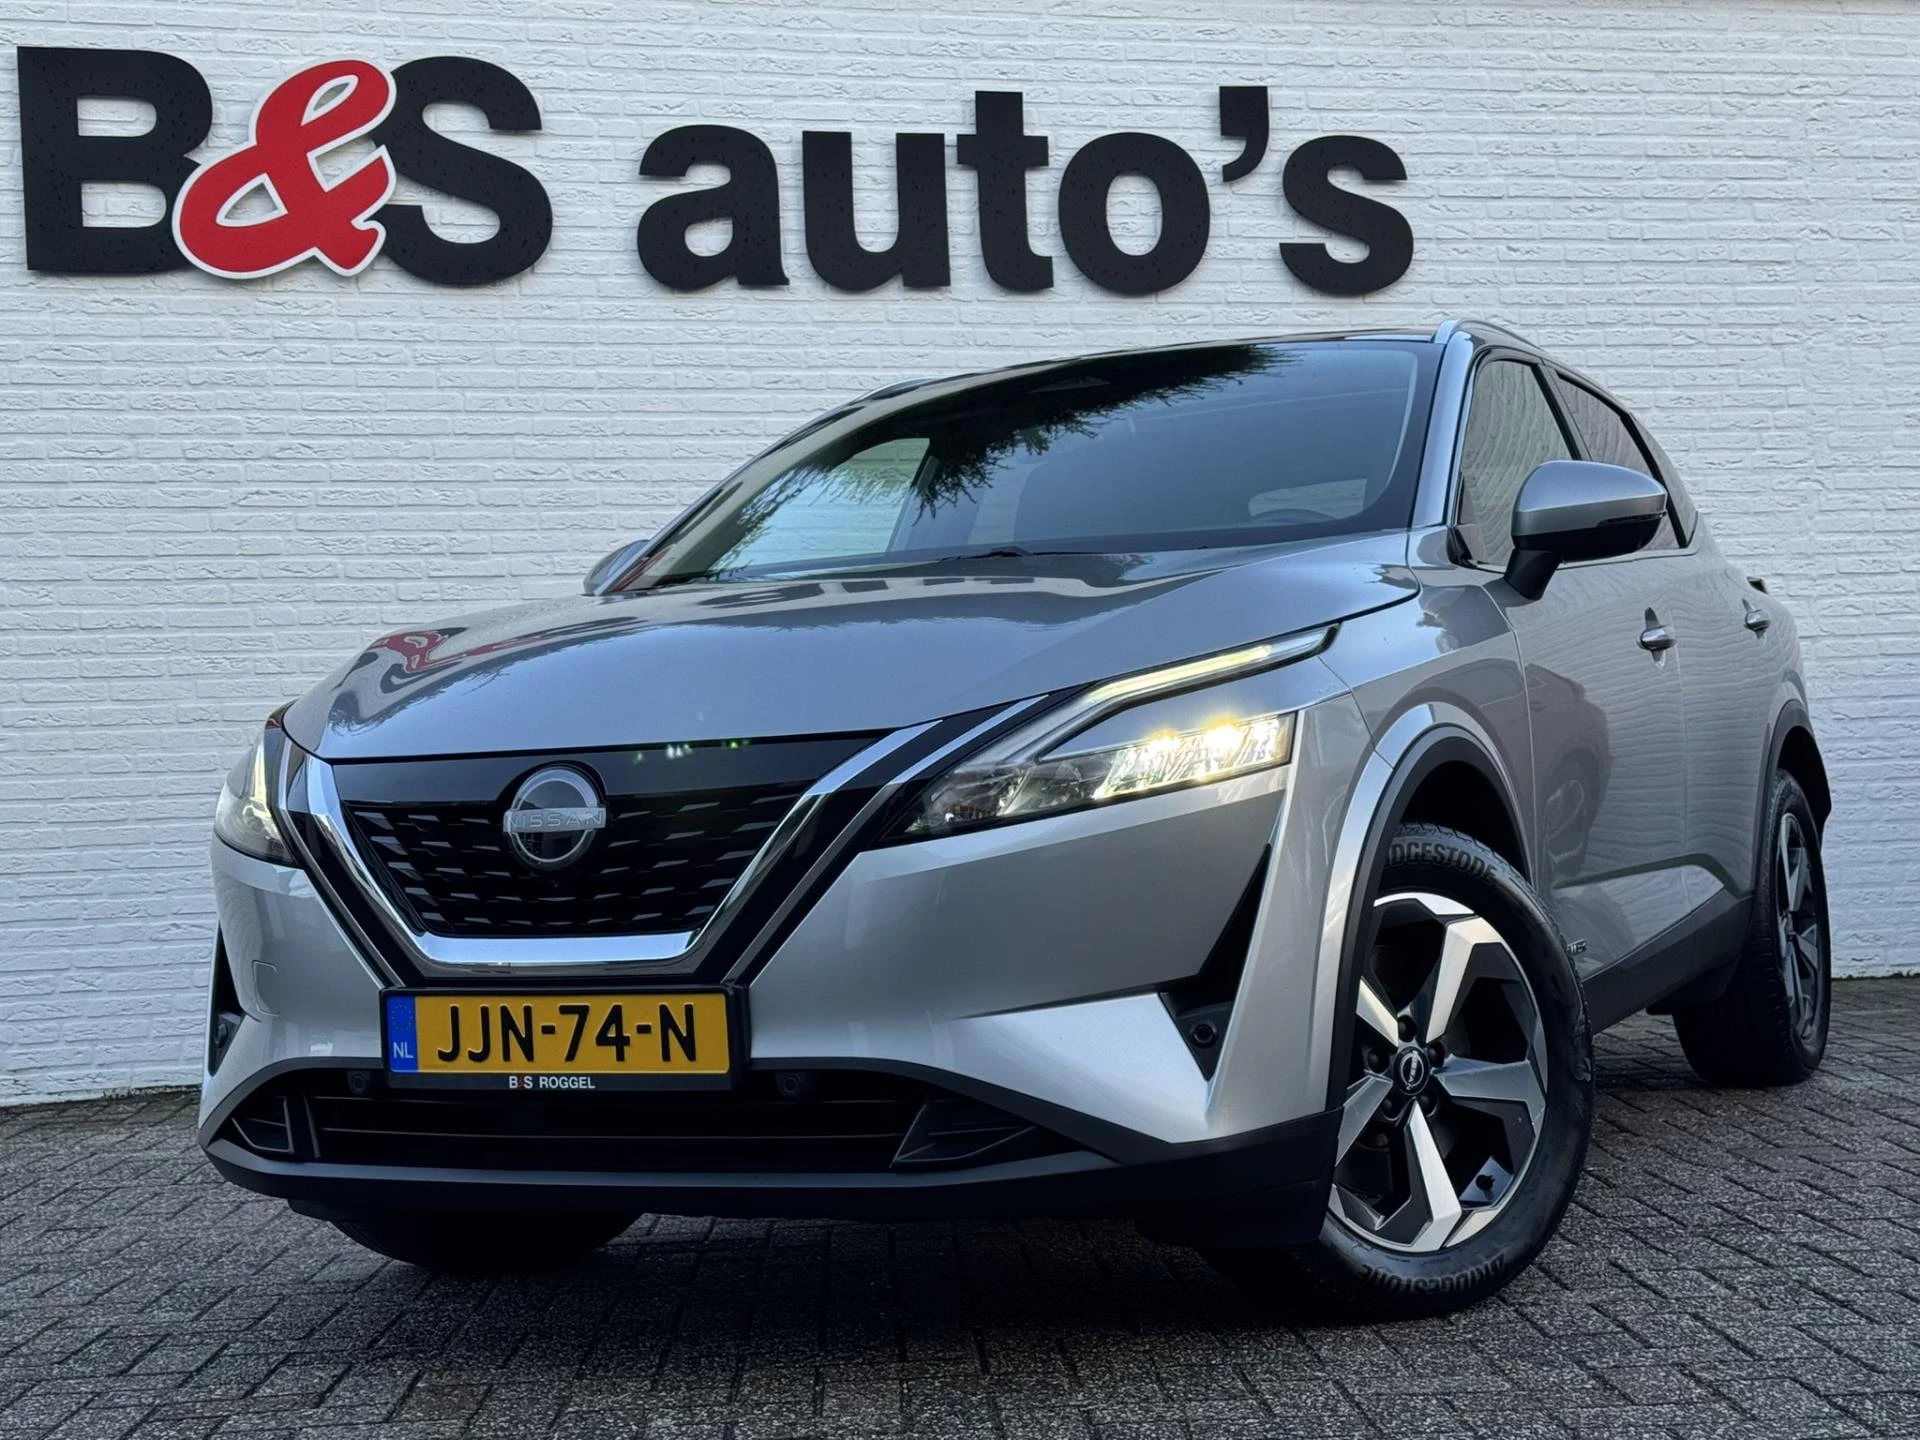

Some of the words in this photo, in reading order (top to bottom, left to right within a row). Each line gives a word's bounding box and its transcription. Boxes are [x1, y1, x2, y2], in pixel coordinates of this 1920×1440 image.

[17, 46, 553, 285] B&S
[637, 85, 1414, 296] auto's
[506, 810, 603, 829] NISSAN
[437, 1002, 697, 1063] JJN-74-N
[393, 1041, 414, 1059] NL
[539, 1076, 596, 1090] ROGGEL
